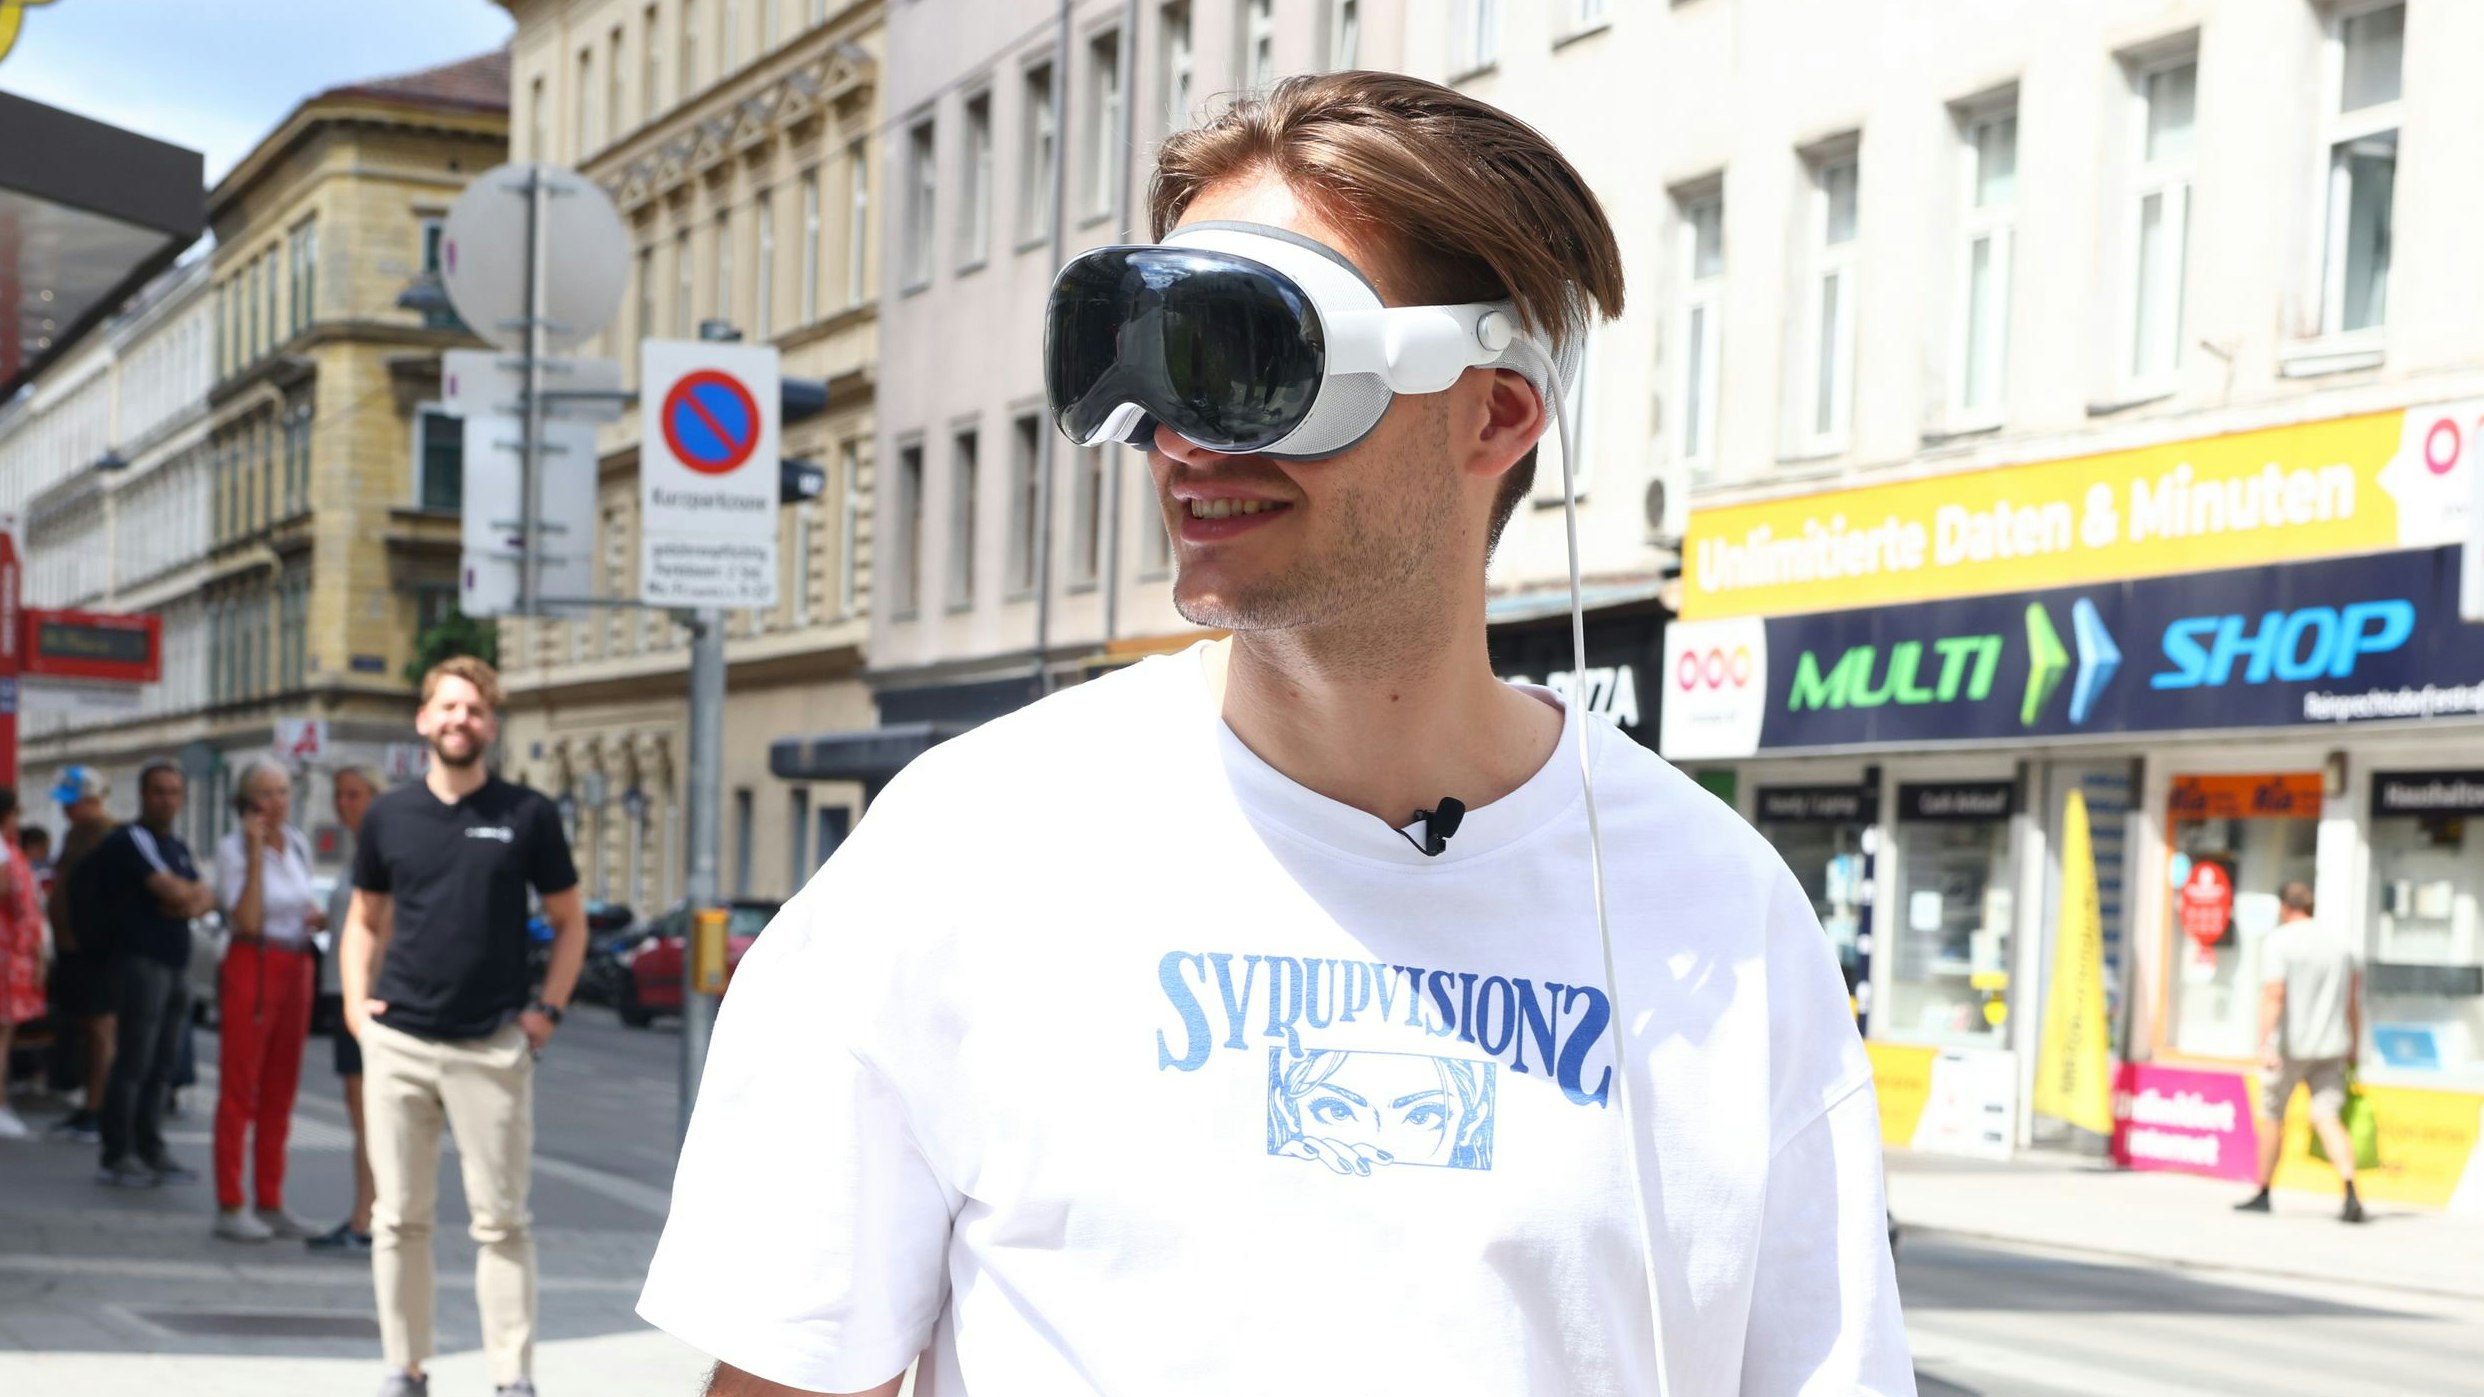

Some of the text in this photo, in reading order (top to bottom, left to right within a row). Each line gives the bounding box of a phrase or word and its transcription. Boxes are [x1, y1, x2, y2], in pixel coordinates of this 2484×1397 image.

[1697, 463, 2355, 592] Unlimitierte Daten & Minuten
[1787, 634, 2003, 712] MULTI
[2150, 600, 2415, 690] SHOP
